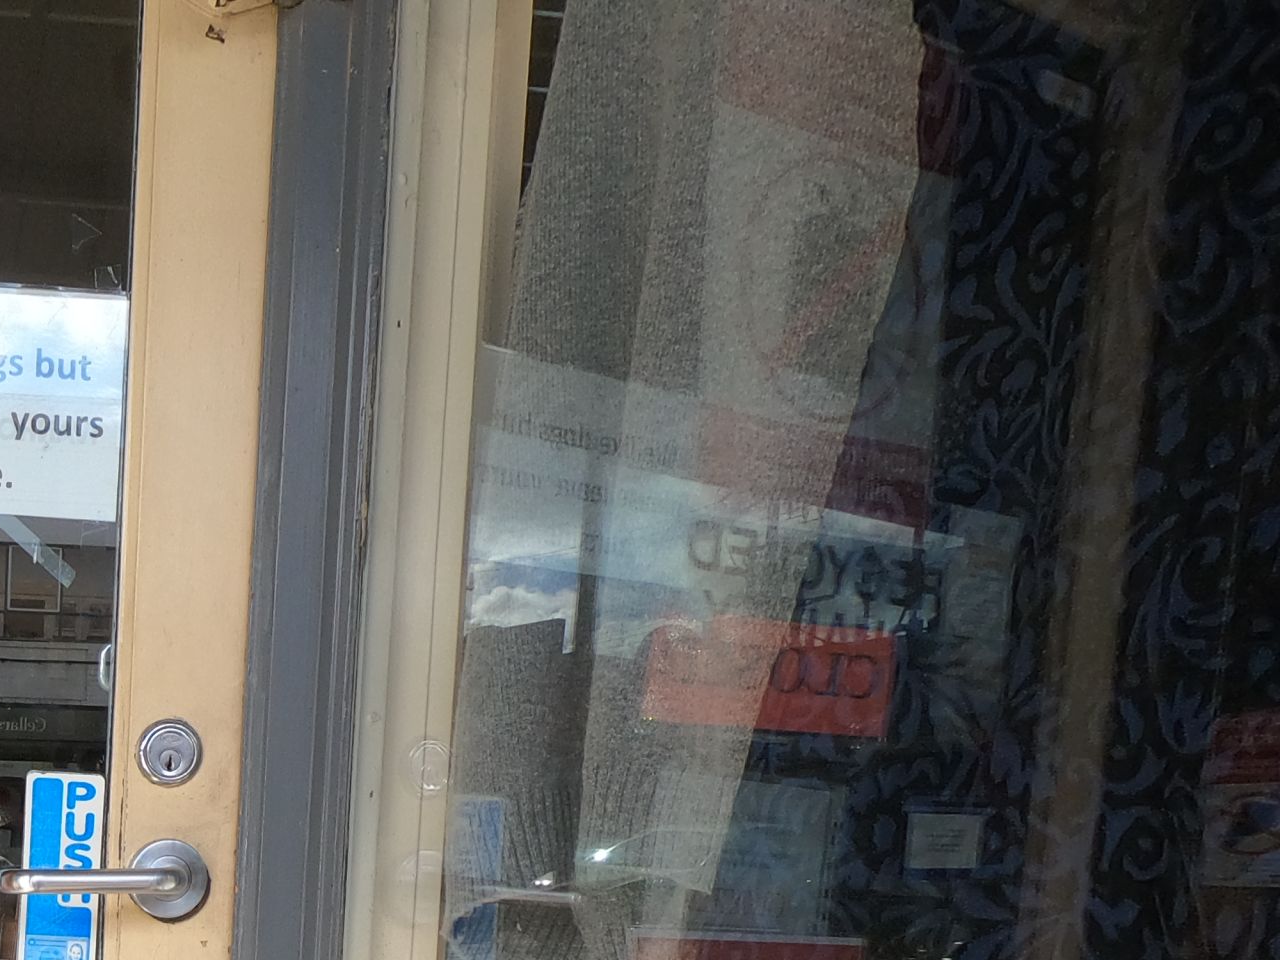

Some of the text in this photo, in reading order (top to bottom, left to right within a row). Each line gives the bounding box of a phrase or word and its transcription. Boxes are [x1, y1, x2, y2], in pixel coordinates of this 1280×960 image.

[35, 348, 92, 382] but
[11, 410, 104, 441] yours
[61, 781, 97, 903] PUS
